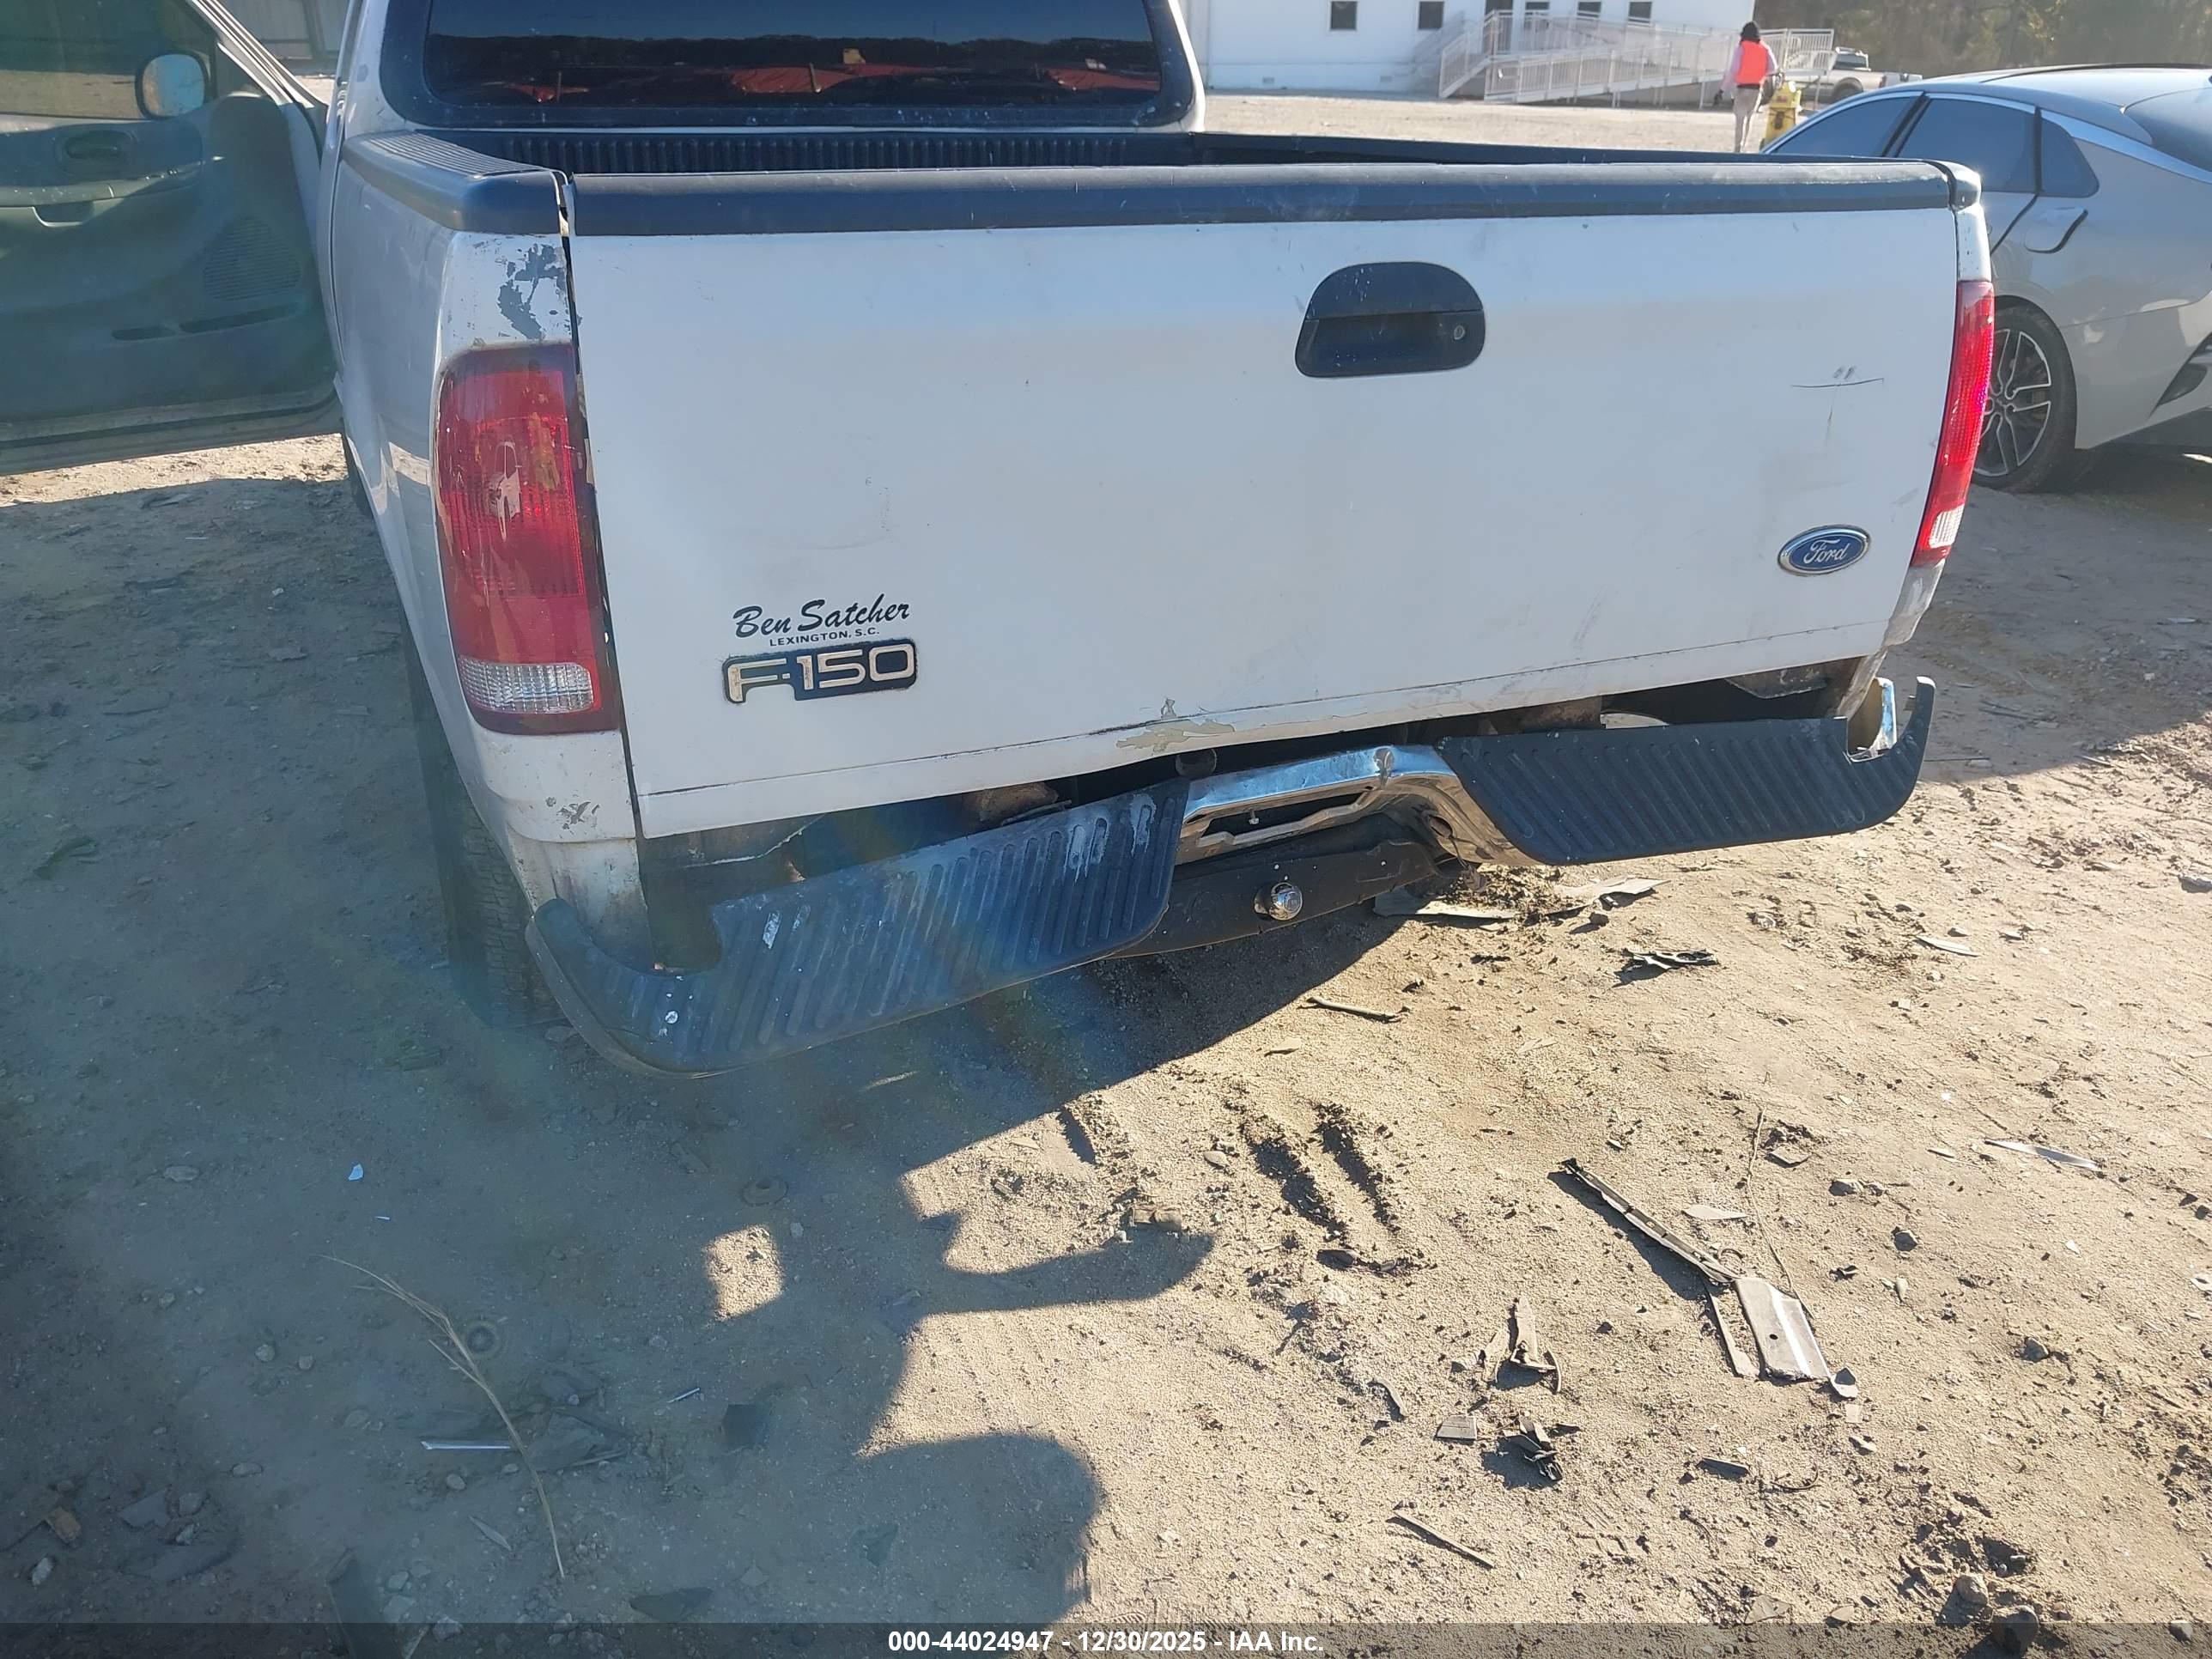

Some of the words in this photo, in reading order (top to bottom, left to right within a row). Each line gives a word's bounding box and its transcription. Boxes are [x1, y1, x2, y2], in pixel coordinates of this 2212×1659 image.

[1803, 538, 1850, 563] Ford
[732, 605, 792, 638] Ben
[797, 593, 910, 632] Satcher
[854, 626, 880, 637] S.C.
[727, 643, 915, 702] F-150
